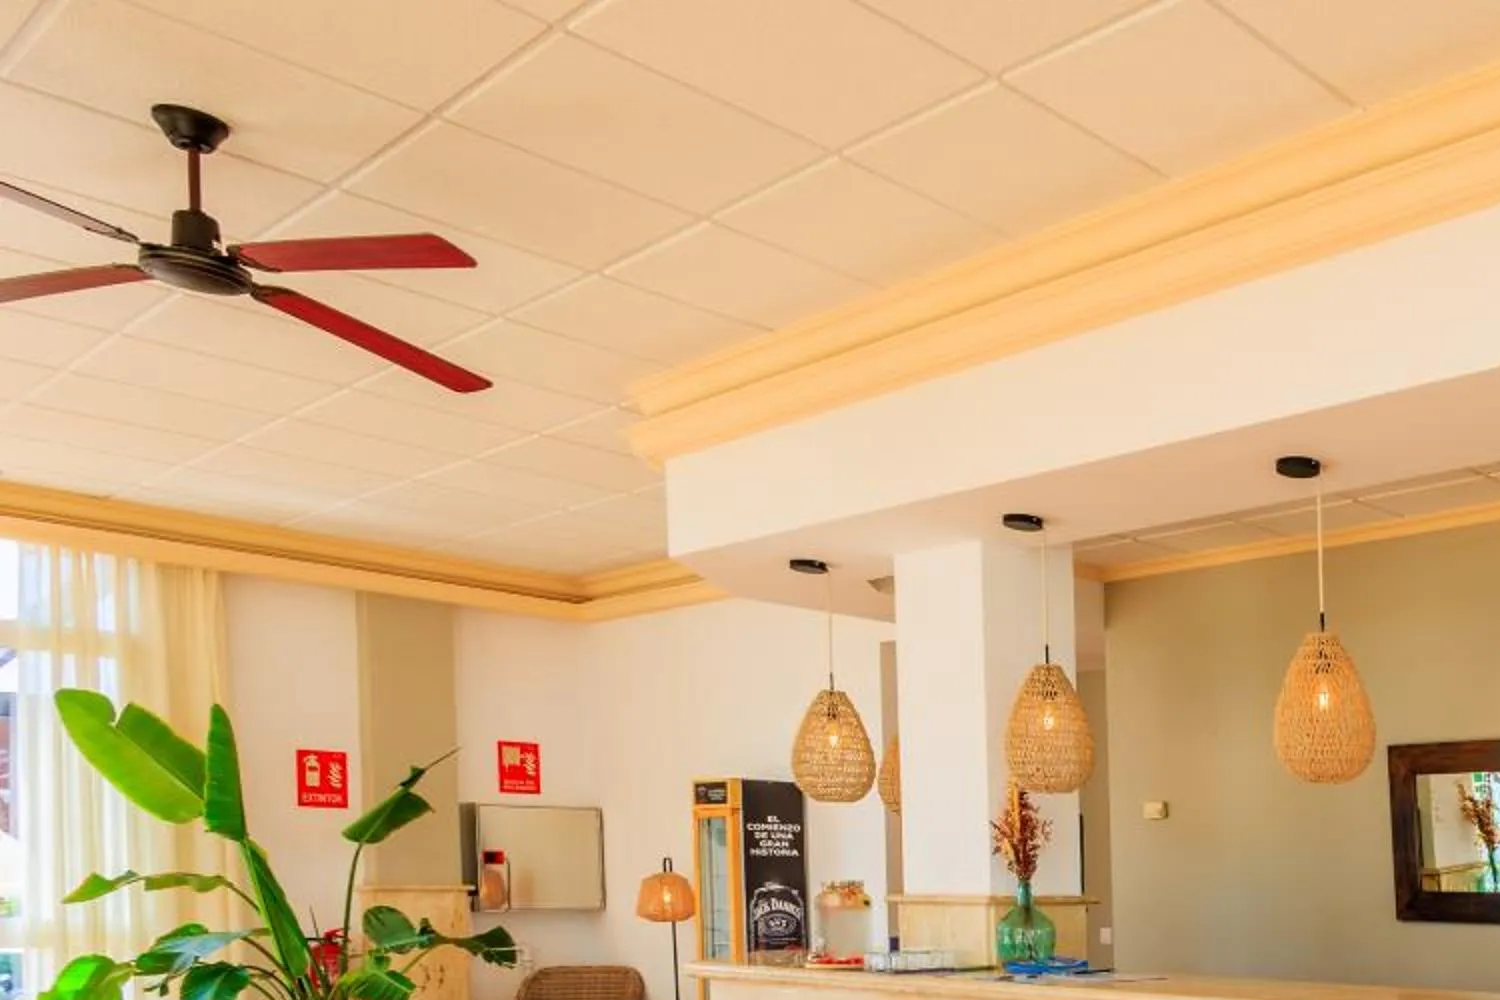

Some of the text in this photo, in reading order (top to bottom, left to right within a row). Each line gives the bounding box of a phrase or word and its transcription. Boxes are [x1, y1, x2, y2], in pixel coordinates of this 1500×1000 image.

[767, 815, 780, 823] EL
[746, 823, 801, 832] COMIENZO
[753, 831, 794, 840] DE UNA
[759, 839, 789, 847] GRAN
[750, 847, 800, 857] HISTORIA
